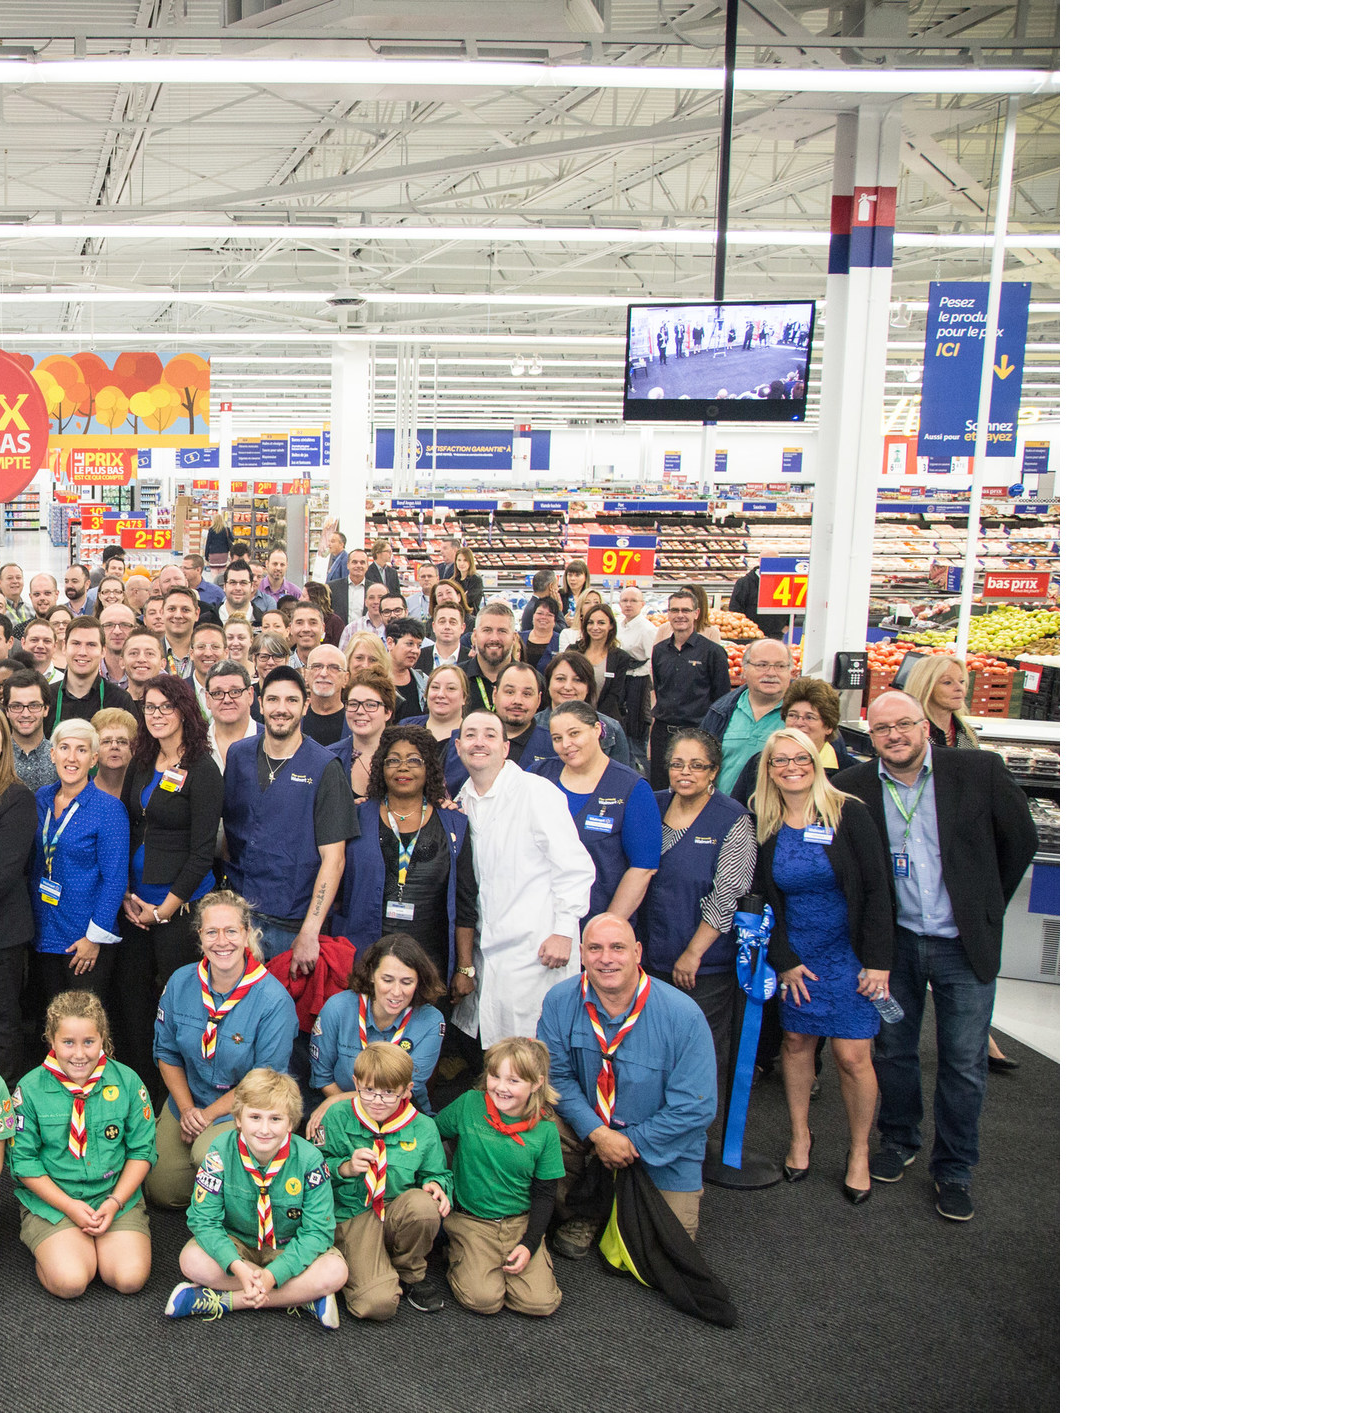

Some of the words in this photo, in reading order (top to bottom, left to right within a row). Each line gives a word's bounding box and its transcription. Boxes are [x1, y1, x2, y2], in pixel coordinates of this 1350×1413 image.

[939, 297, 975, 308] Pesez
[938, 311, 949, 323] le
[950, 311, 987, 324] produ
[936, 327, 967, 339] pour
[968, 326, 979, 337] le
[979, 329, 1004, 340] px
[936, 343, 960, 357] ICI
[965, 420, 1013, 431] Scnnez
[924, 433, 943, 441] Aussi
[964, 431, 975, 441] et
[987, 433, 1012, 444] ayez
[85, 452, 124, 466] PRIX
[85, 466, 107, 474] PLUS
[108, 466, 124, 474] BAS
[116, 520, 142, 535] 647$
[603, 550, 641, 574] 97¢
[987, 576, 1010, 589] bas
[1011, 578, 1037, 592] prix
